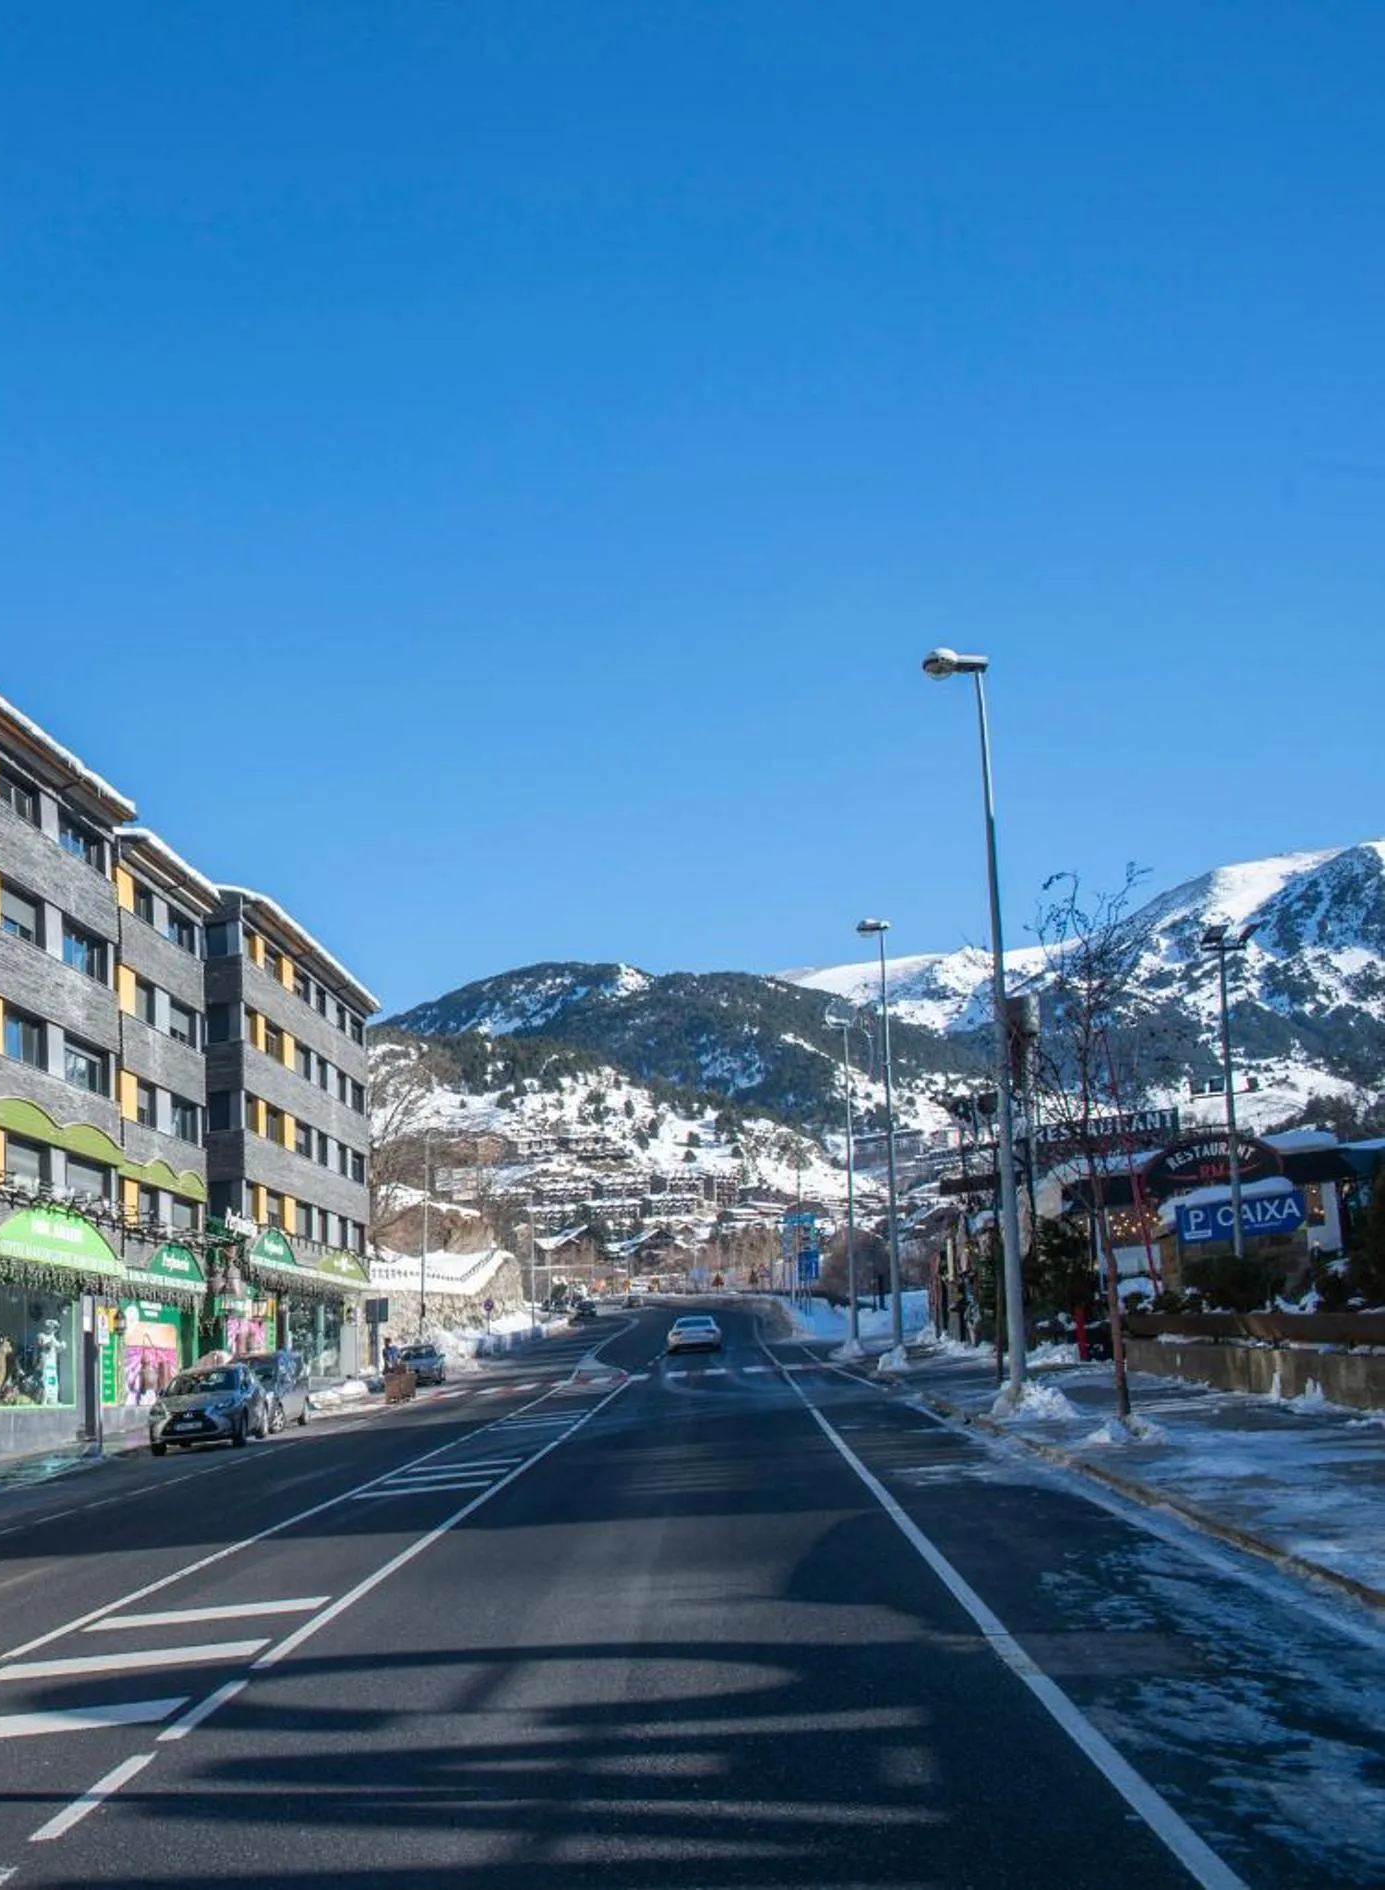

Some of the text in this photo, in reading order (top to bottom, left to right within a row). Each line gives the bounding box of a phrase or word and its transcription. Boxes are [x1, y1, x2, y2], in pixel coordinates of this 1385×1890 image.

[1166, 1142, 1256, 1171] RESTAURNT
[1189, 1197, 1302, 1231] P CAIXA
